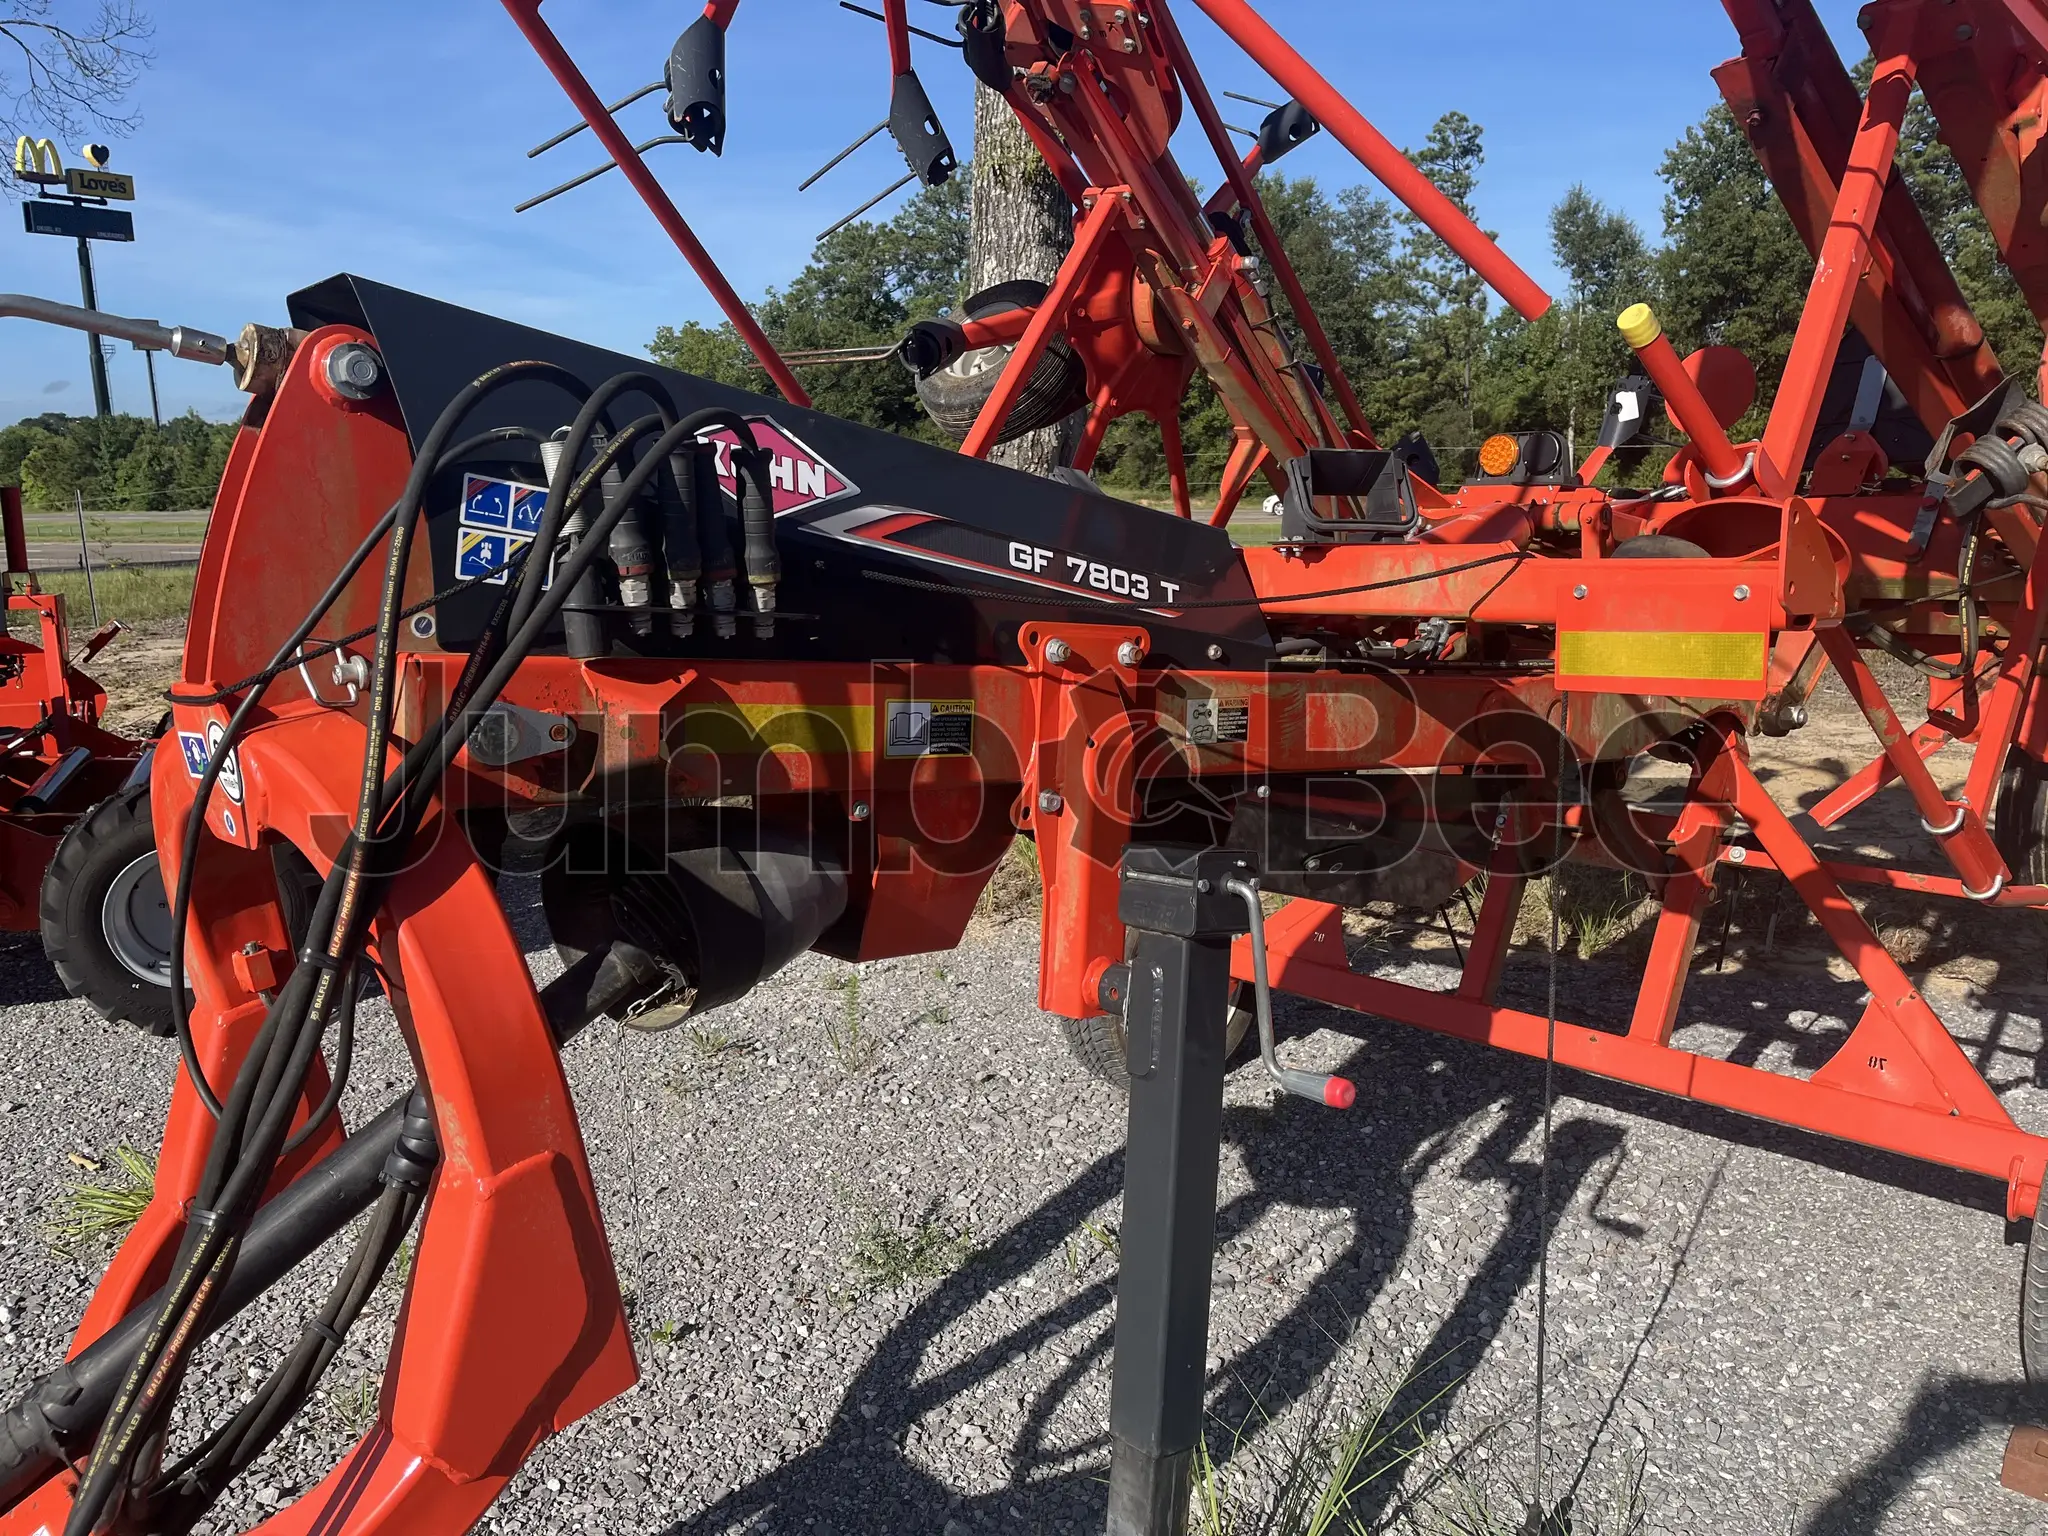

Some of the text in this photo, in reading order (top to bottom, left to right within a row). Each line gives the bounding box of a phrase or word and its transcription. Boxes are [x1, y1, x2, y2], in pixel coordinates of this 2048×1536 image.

[78, 173, 127, 194] Love's
[696, 435, 826, 499] KHN
[389, 555, 399, 576] MSHA
[1008, 541, 1180, 603] GF 7803 T
[384, 581, 394, 612] Resistant
[491, 598, 508, 626] EXCEEDS
[381, 613, 390, 633] Flame
[464, 653, 482, 688] PREMIUM
[940, 704, 971, 714] CAUTION
[358, 807, 370, 842] EXCEEDS
[340, 880, 357, 920] PREMIUM
[313, 973, 331, 1009] BALFLEX
[157, 1304, 174, 1327] Flame
[169, 1268, 193, 1303] Resistant
[190, 1242, 207, 1265] MSHA
[146, 1358, 172, 1398] BALPAC
[170, 1310, 197, 1354] PREMIUM
[192, 1277, 213, 1311] R16-6K
[116, 1412, 142, 1452] BALFLEX
